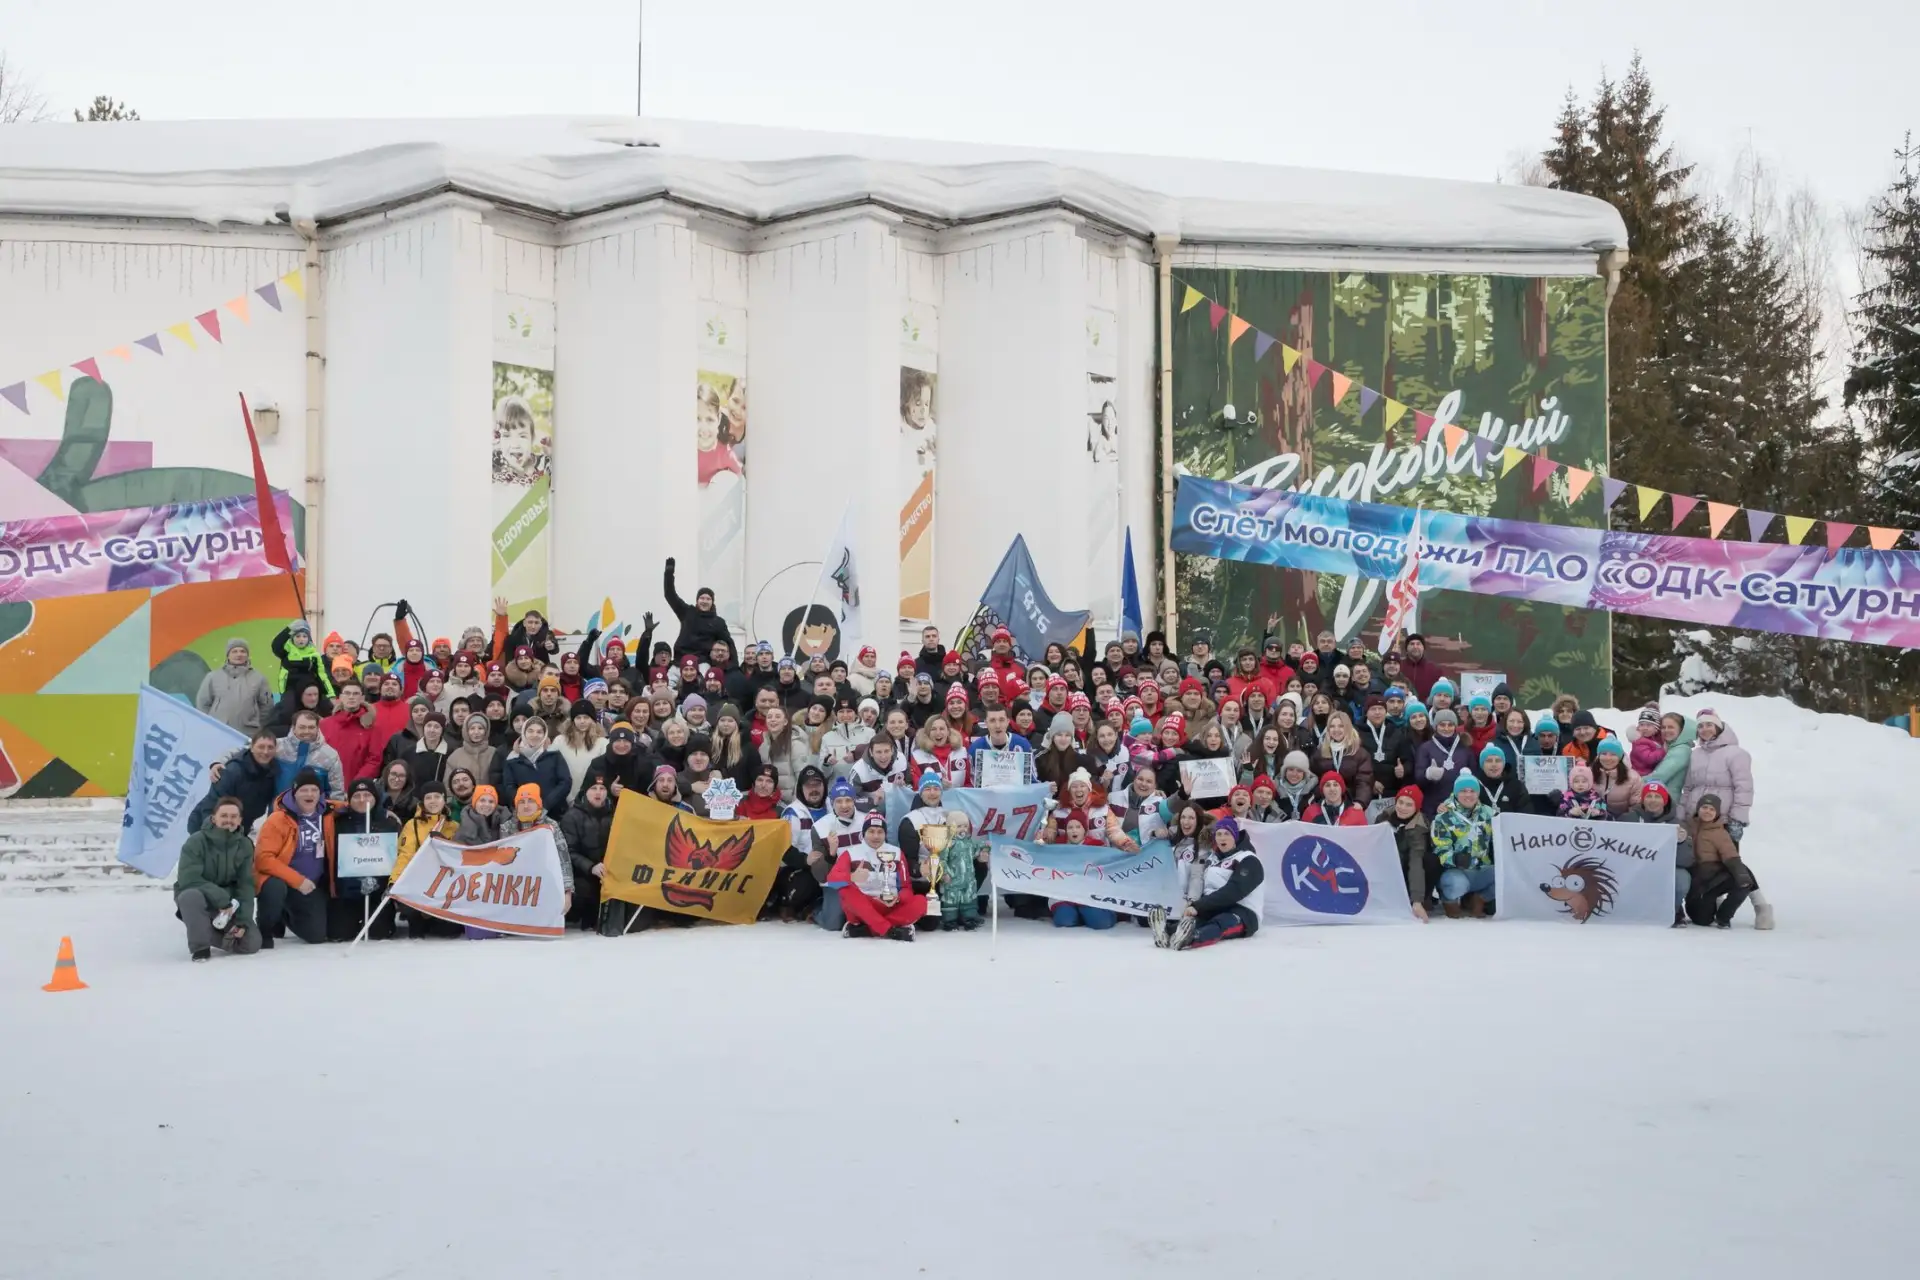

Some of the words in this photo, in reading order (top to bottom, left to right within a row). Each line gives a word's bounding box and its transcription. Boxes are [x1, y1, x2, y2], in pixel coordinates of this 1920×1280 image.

[1192, 505, 1275, 540] Слёт
[1495, 547, 1588, 582] ПАО
[977, 804, 1038, 841] 47
[353, 856, 384, 865] Гренки
[631, 864, 754, 894] ФЕНИКС
